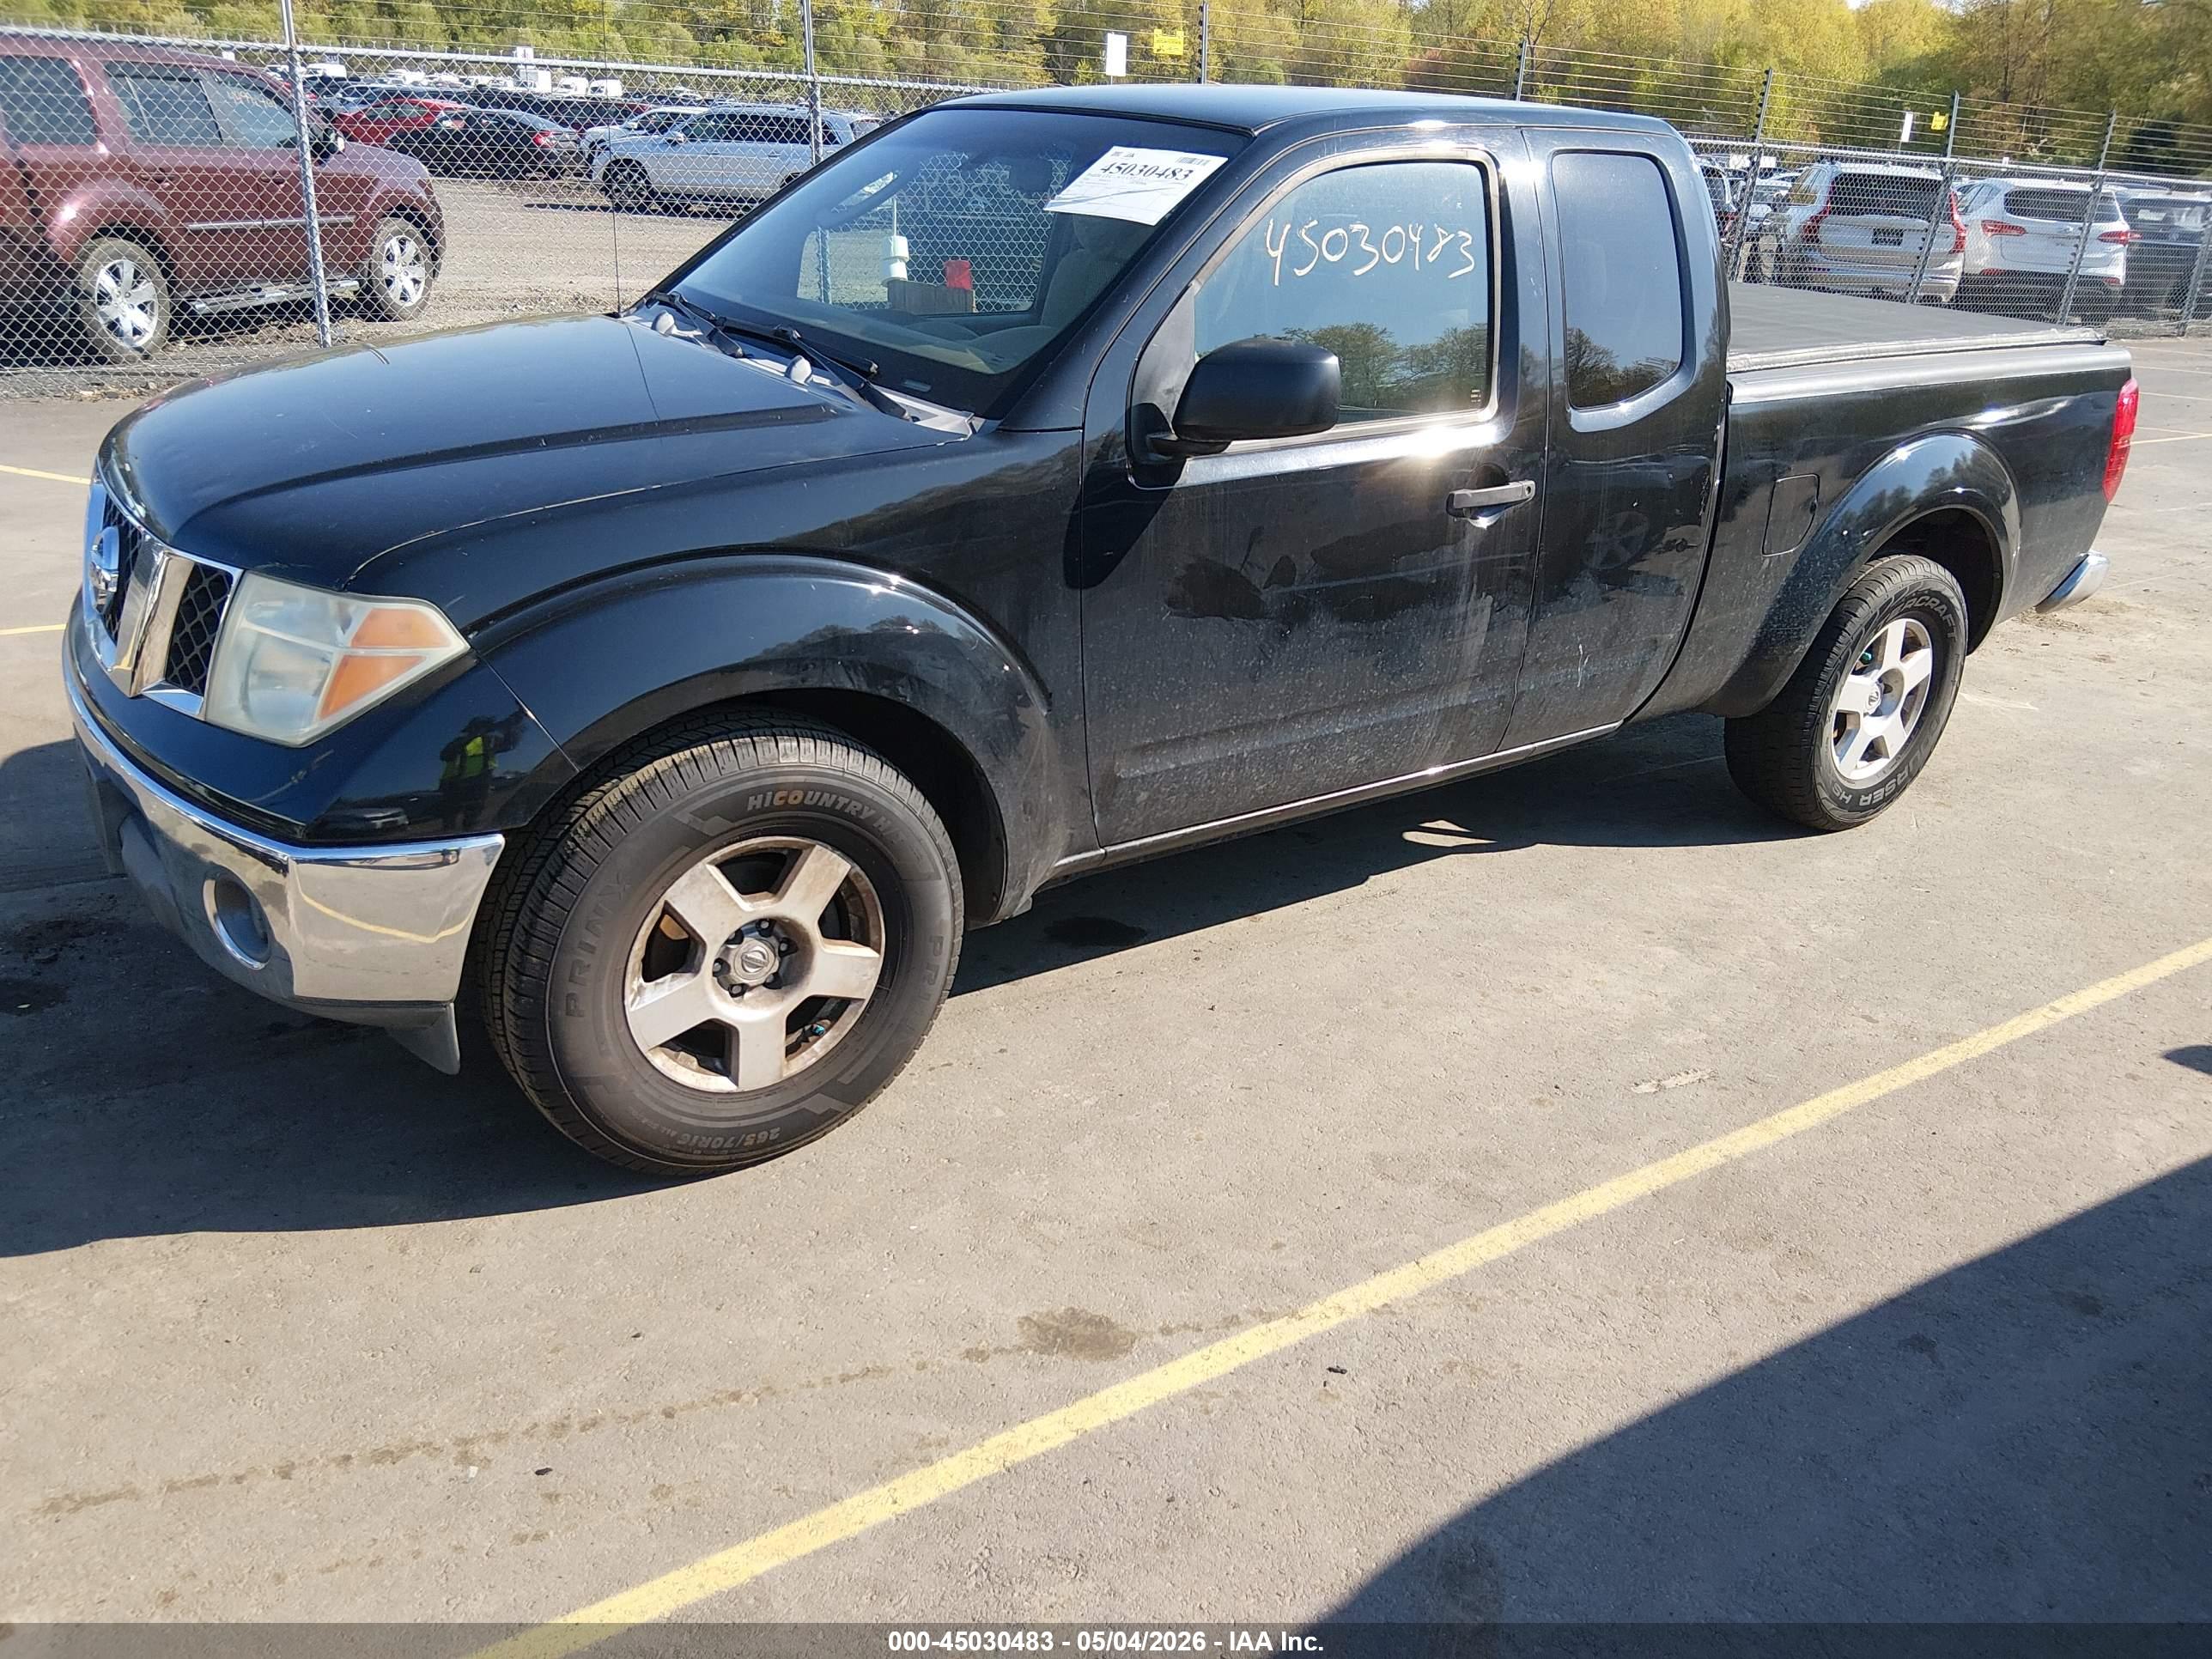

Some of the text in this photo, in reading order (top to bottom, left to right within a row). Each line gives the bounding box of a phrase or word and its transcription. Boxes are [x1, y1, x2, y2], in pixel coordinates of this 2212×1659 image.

[1100, 161, 1194, 181] 45030483
[1265, 217, 1475, 287] 45030483
[746, 789, 876, 819] HICOUNTRY
[1832, 782, 1853, 804] HS
[678, 1127, 781, 1148] 265/70R16
